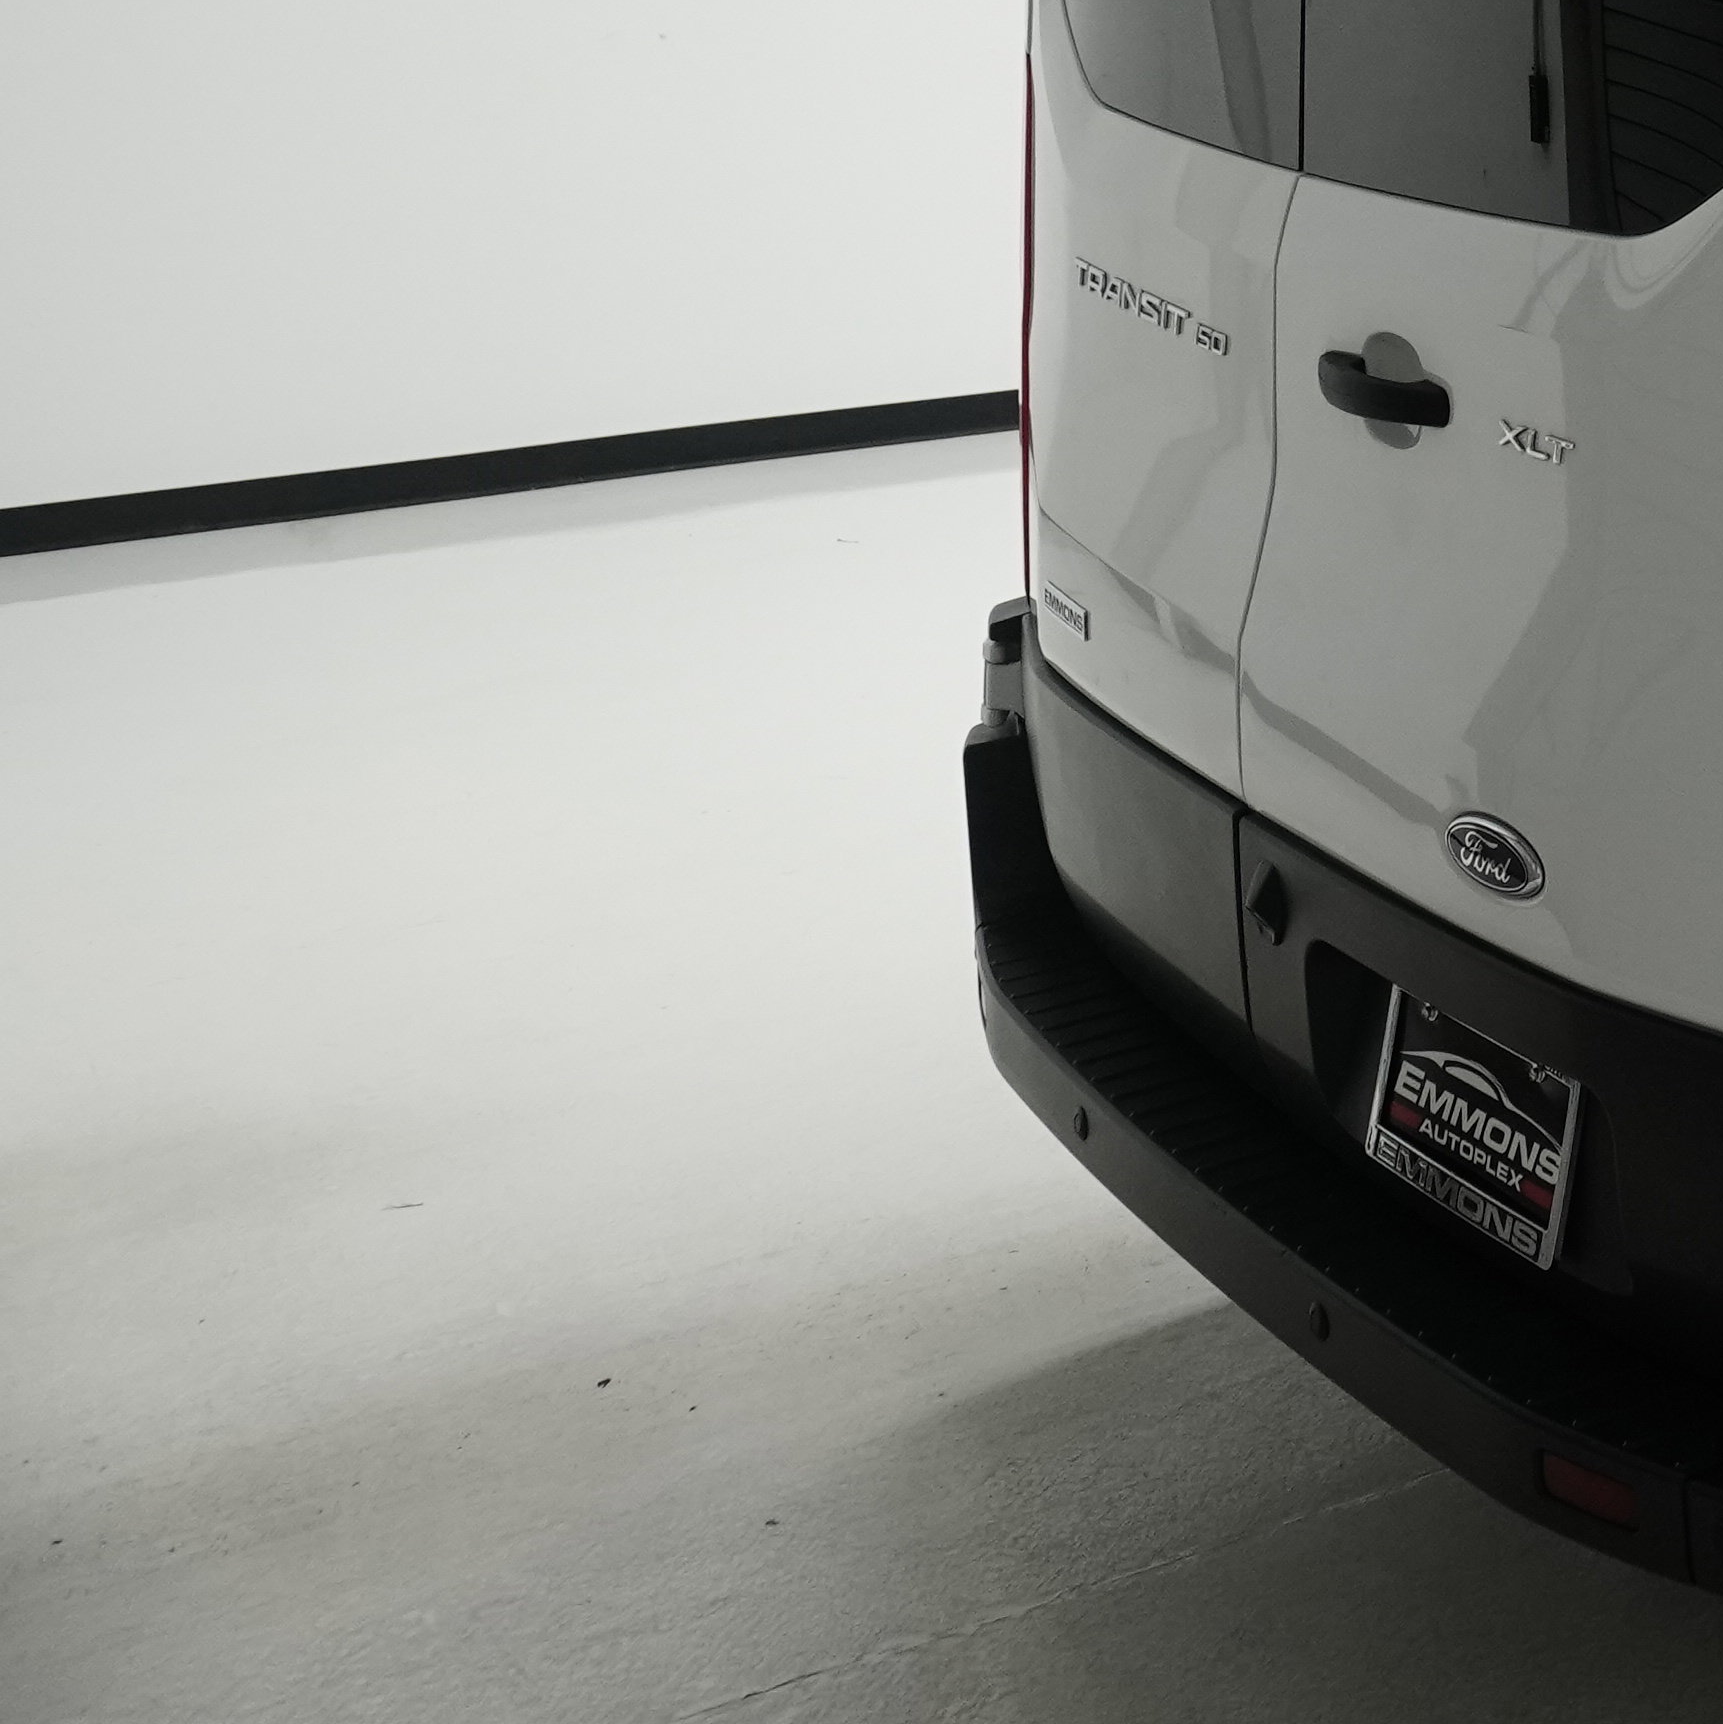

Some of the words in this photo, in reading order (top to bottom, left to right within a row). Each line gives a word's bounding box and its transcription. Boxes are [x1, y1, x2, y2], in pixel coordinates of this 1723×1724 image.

[1074, 256, 1192, 335] TRANSIT
[1498, 419, 1576, 465] XLT
[1044, 588, 1083, 632] EMMONS
[1459, 830, 1512, 883] Ford
[1394, 1060, 1561, 1185] EMMONS
[1418, 1119, 1524, 1192] AUTOPLEX
[1377, 1135, 1538, 1257] EMMONS
